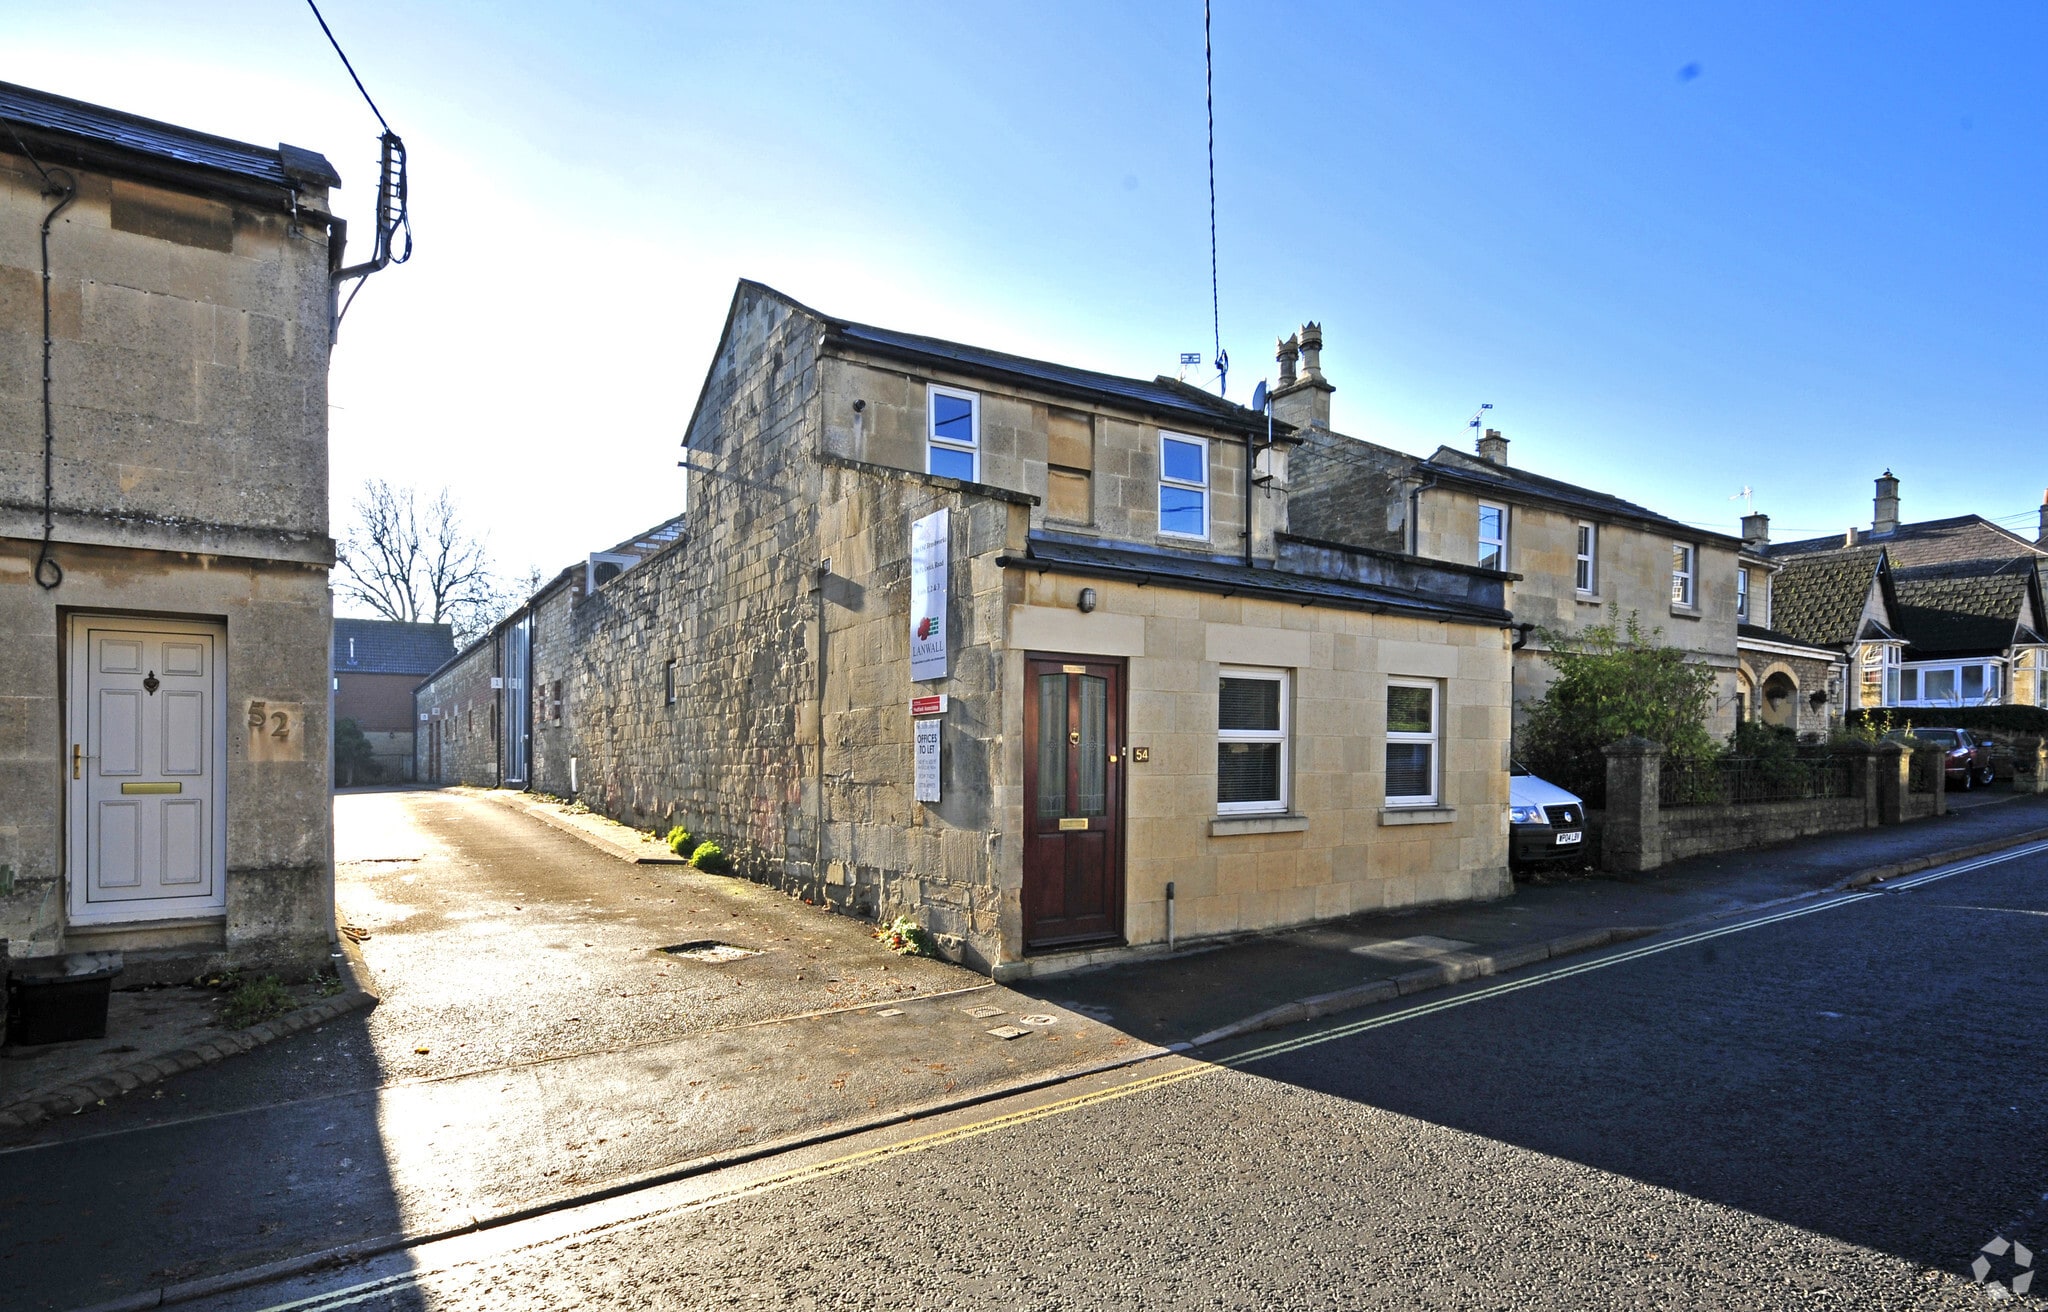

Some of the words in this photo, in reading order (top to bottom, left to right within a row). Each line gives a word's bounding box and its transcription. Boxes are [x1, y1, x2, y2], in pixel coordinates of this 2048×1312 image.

[912, 641, 943, 657] LANWALL
[248, 700, 290, 737] 52
[917, 733, 937, 744] OFFICES
[919, 745, 926, 754] TO
[927, 744, 935, 754] LET
[1136, 749, 1148, 761] 54
